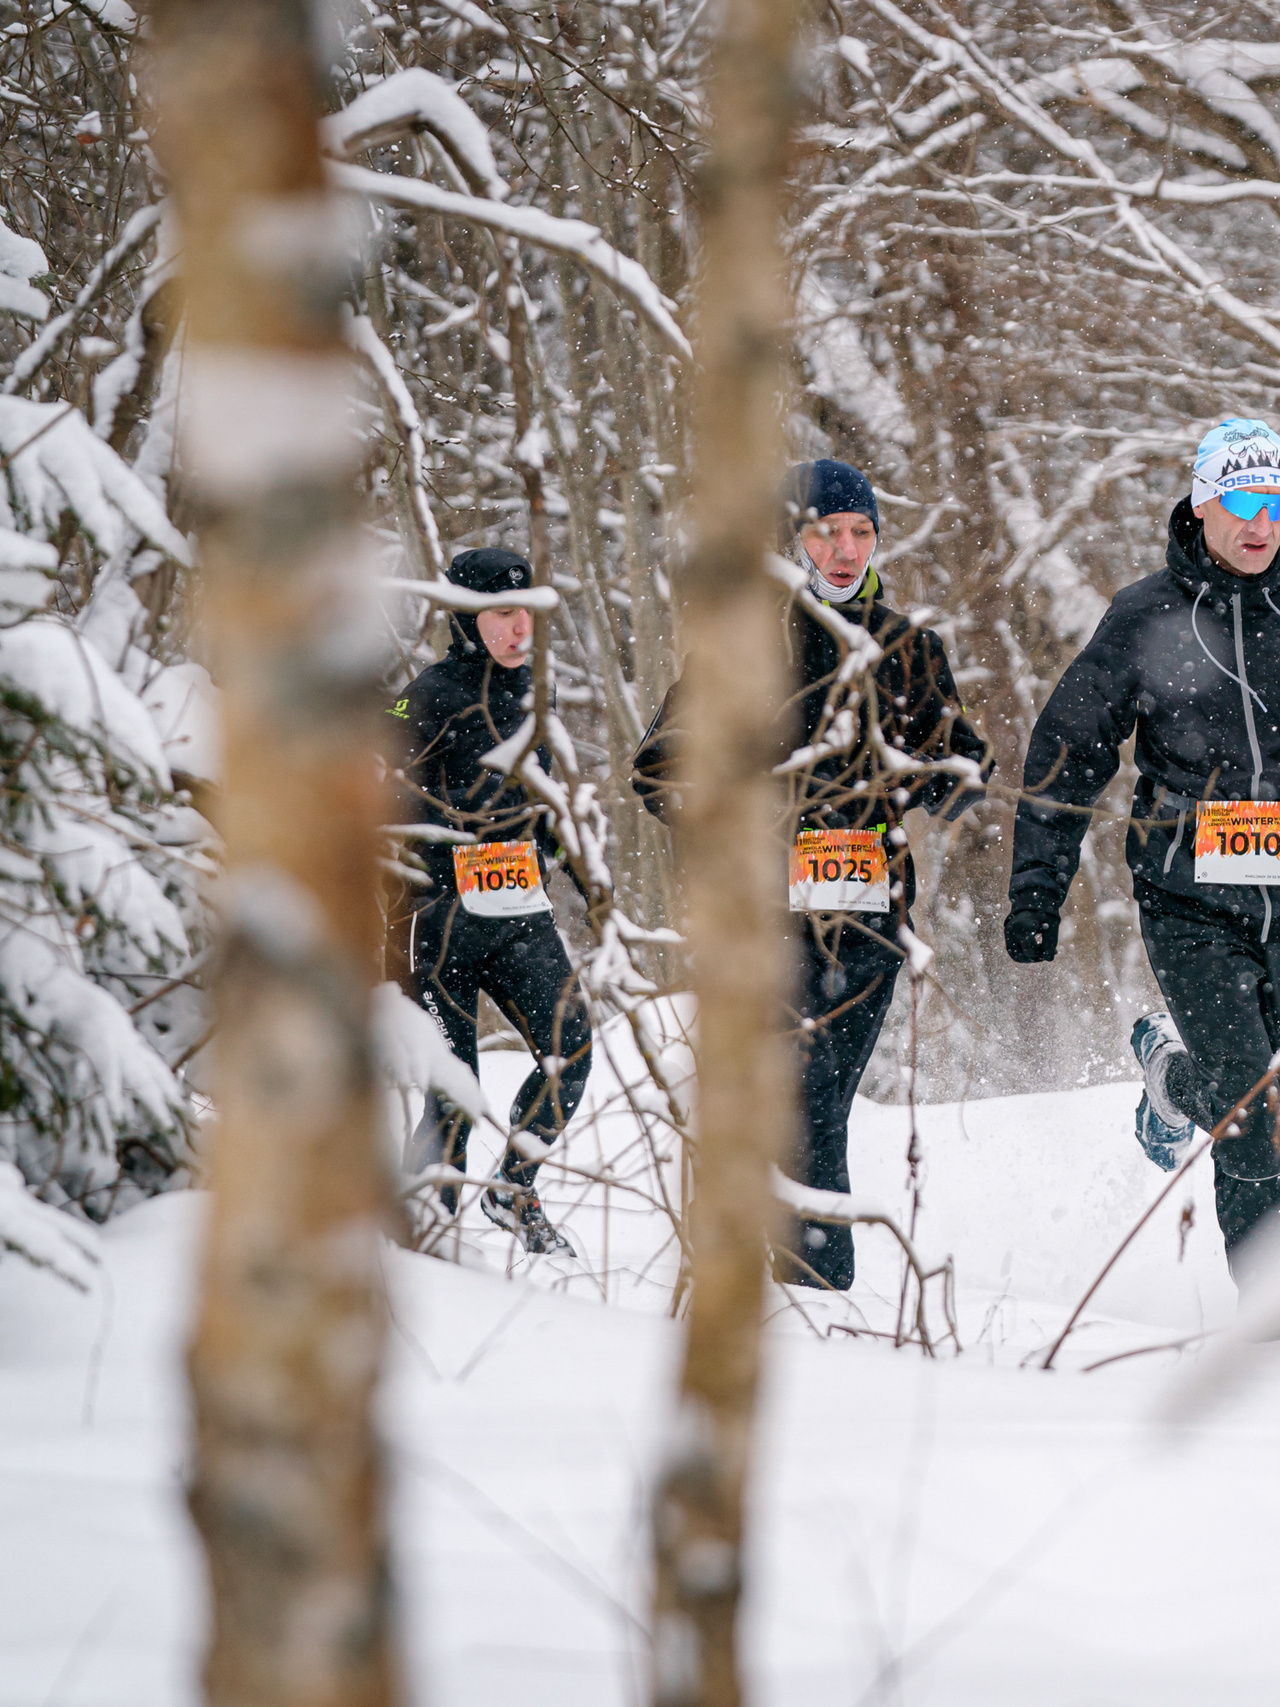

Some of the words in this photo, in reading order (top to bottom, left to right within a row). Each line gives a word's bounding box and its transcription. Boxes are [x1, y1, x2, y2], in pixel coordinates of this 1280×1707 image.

[1230, 817, 1274, 826] WINTER
[822, 844, 863, 853] WINTER
[808, 859, 872, 883] 1025
[474, 868, 528, 892] 1056
